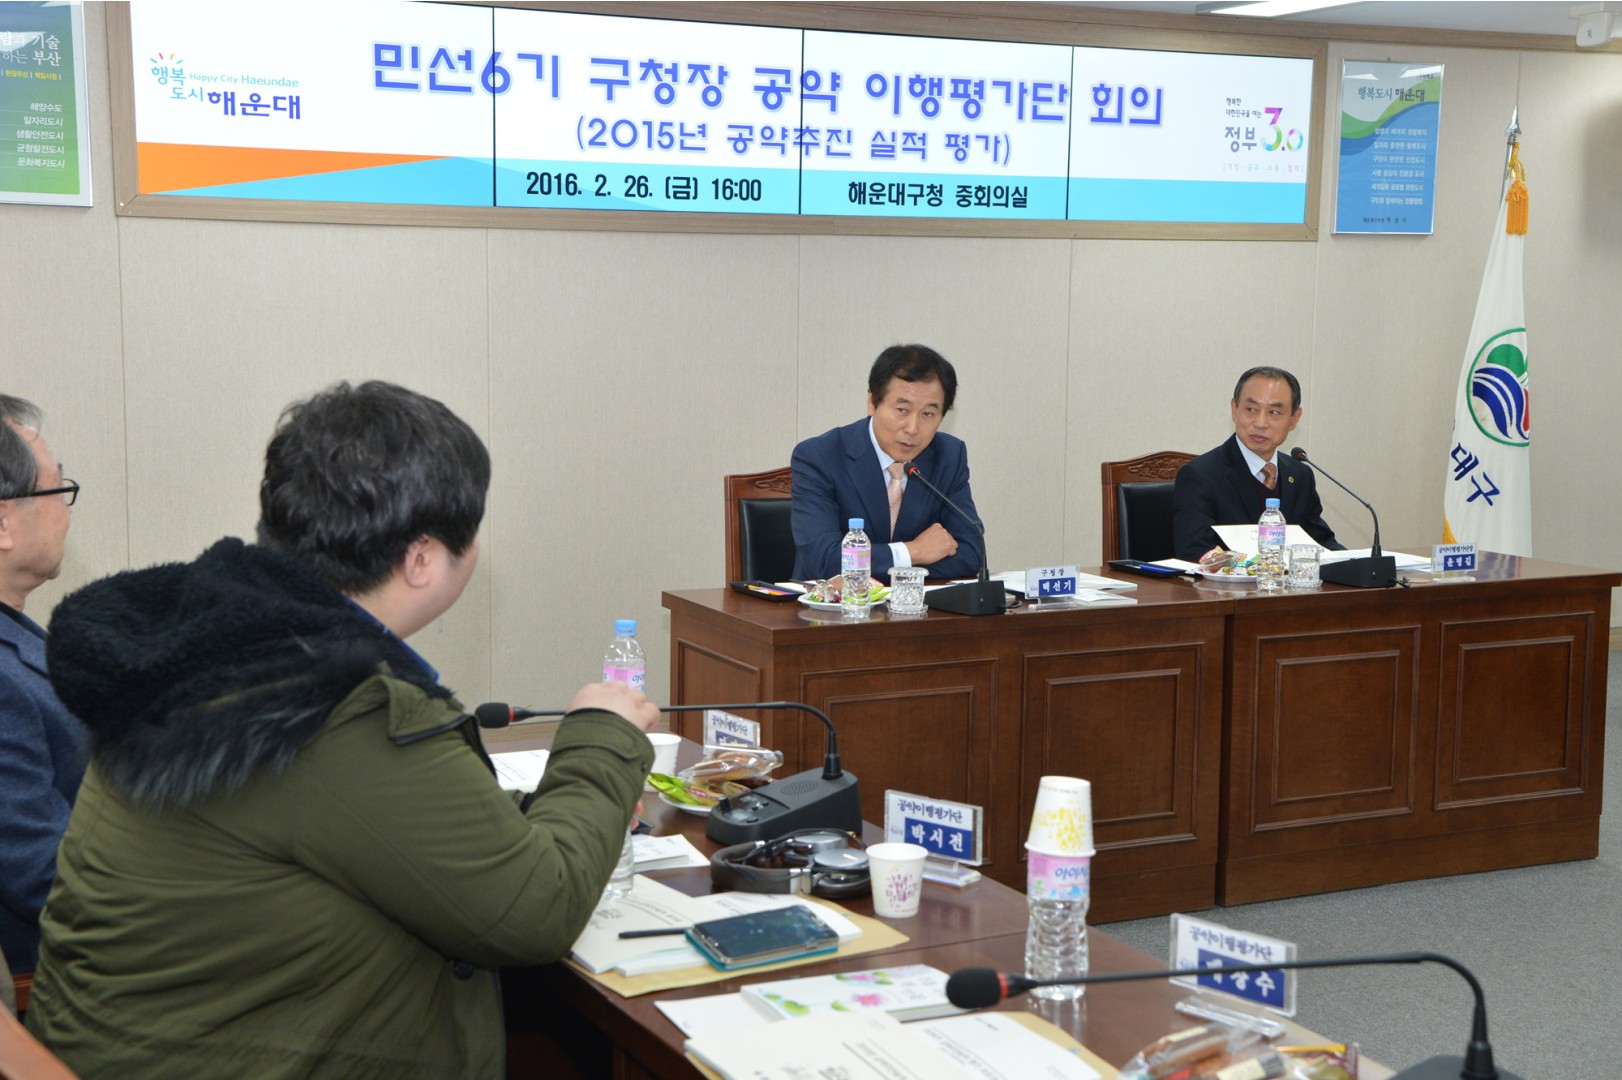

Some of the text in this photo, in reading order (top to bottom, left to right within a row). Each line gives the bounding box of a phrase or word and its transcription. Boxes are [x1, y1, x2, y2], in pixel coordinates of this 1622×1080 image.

[31, 33, 61, 50] 기술
[32, 49, 61, 67] 부산
[151, 66, 186, 86] 행복
[189, 73, 299, 88] Happy City Haeundae
[373, 42, 1164, 126] 민선6기 구청장 공약 이행평가단 회의
[170, 86, 301, 120] 도시 해운대
[1225, 97, 1242, 106] 행복한
[1358, 86, 1426, 103] 행복도시 해운대
[30, 102, 63, 112] 해양수도
[1225, 108, 1250, 118] 대한민국을
[23, 115, 63, 127] 일자리도시
[15, 129, 64, 141] 생활안전도시
[577, 115, 1011, 166] (2015년 공약추진 실적 평가)
[1224, 126, 1257, 153] 정부
[17, 156, 65, 169] 문화복지도시
[526, 172, 582, 196] 2016.
[594, 174, 611, 197] 2.
[624, 176, 653, 198] 26.
[711, 178, 762, 202] 16:00
[848, 180, 1029, 209] 해운대구청 중회의실
[1041, 567, 1065, 577] 구청장
[897, 799, 963, 824] 공약이행평가단
[1189, 925, 1273, 964] 공약이행평가단
